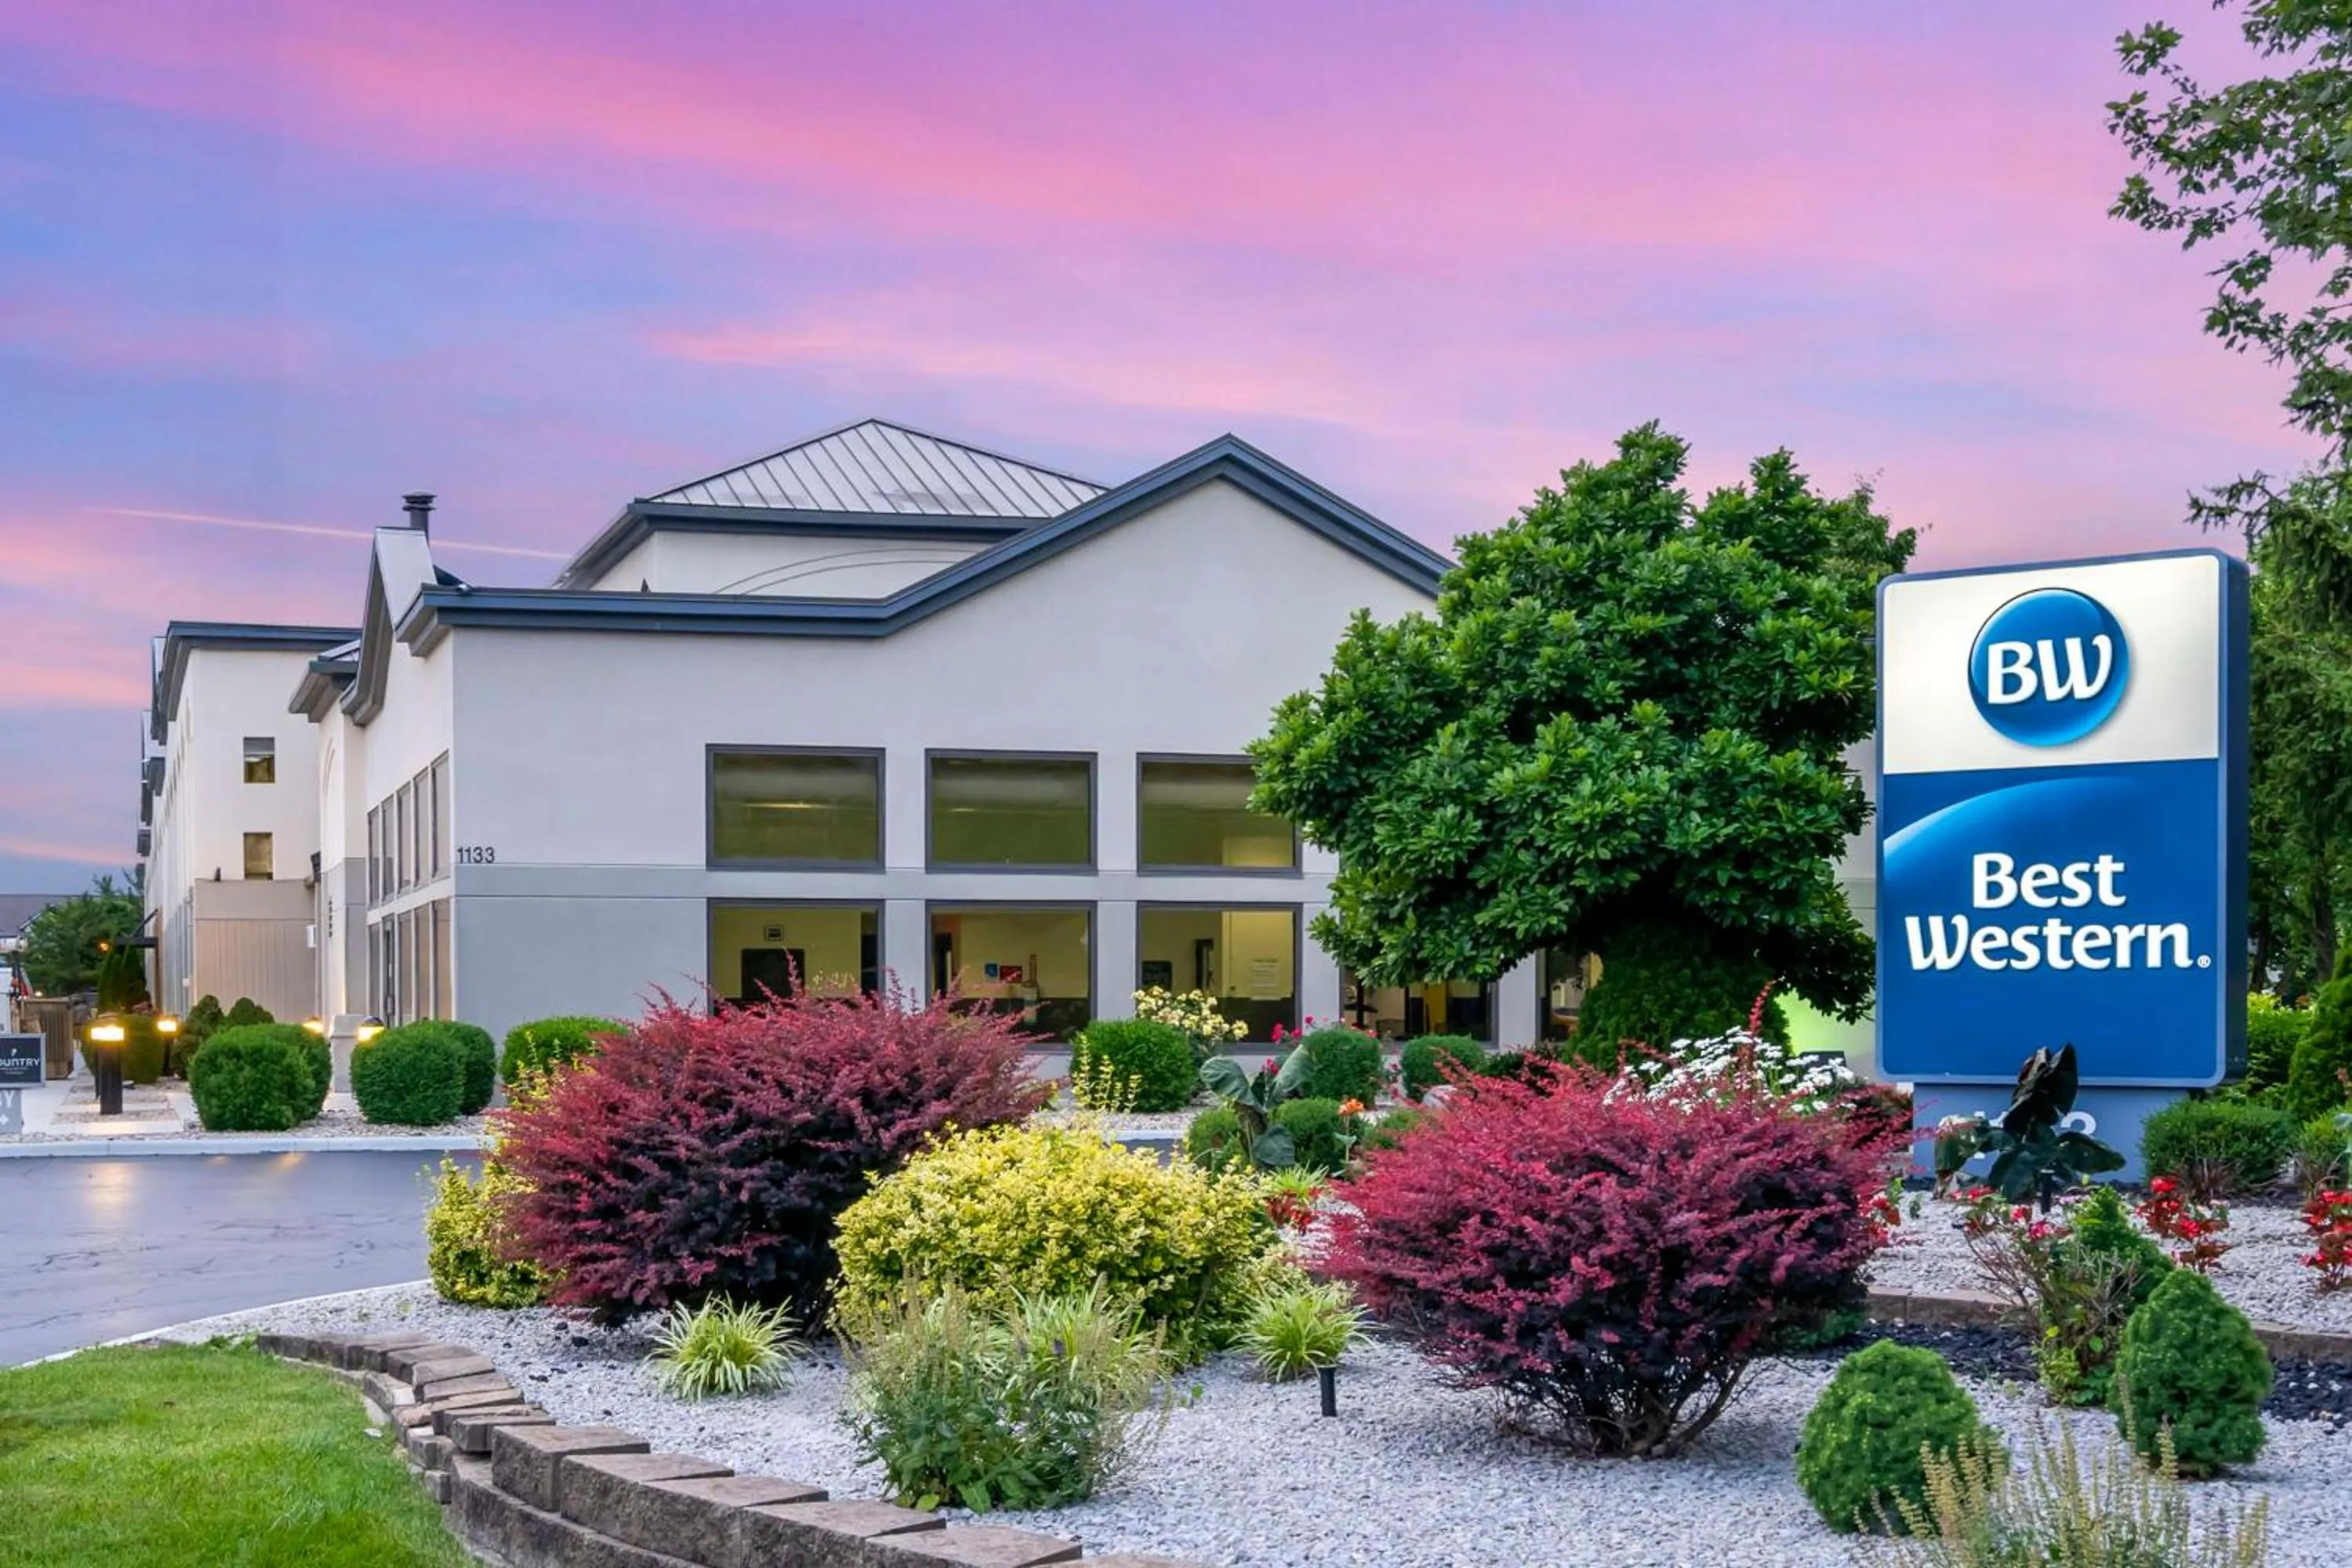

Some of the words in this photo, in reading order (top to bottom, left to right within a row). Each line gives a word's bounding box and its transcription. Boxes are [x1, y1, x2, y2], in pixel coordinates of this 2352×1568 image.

[1987, 634, 2113, 705] BW
[457, 846, 495, 864] 1133
[1973, 852, 2126, 909] Best
